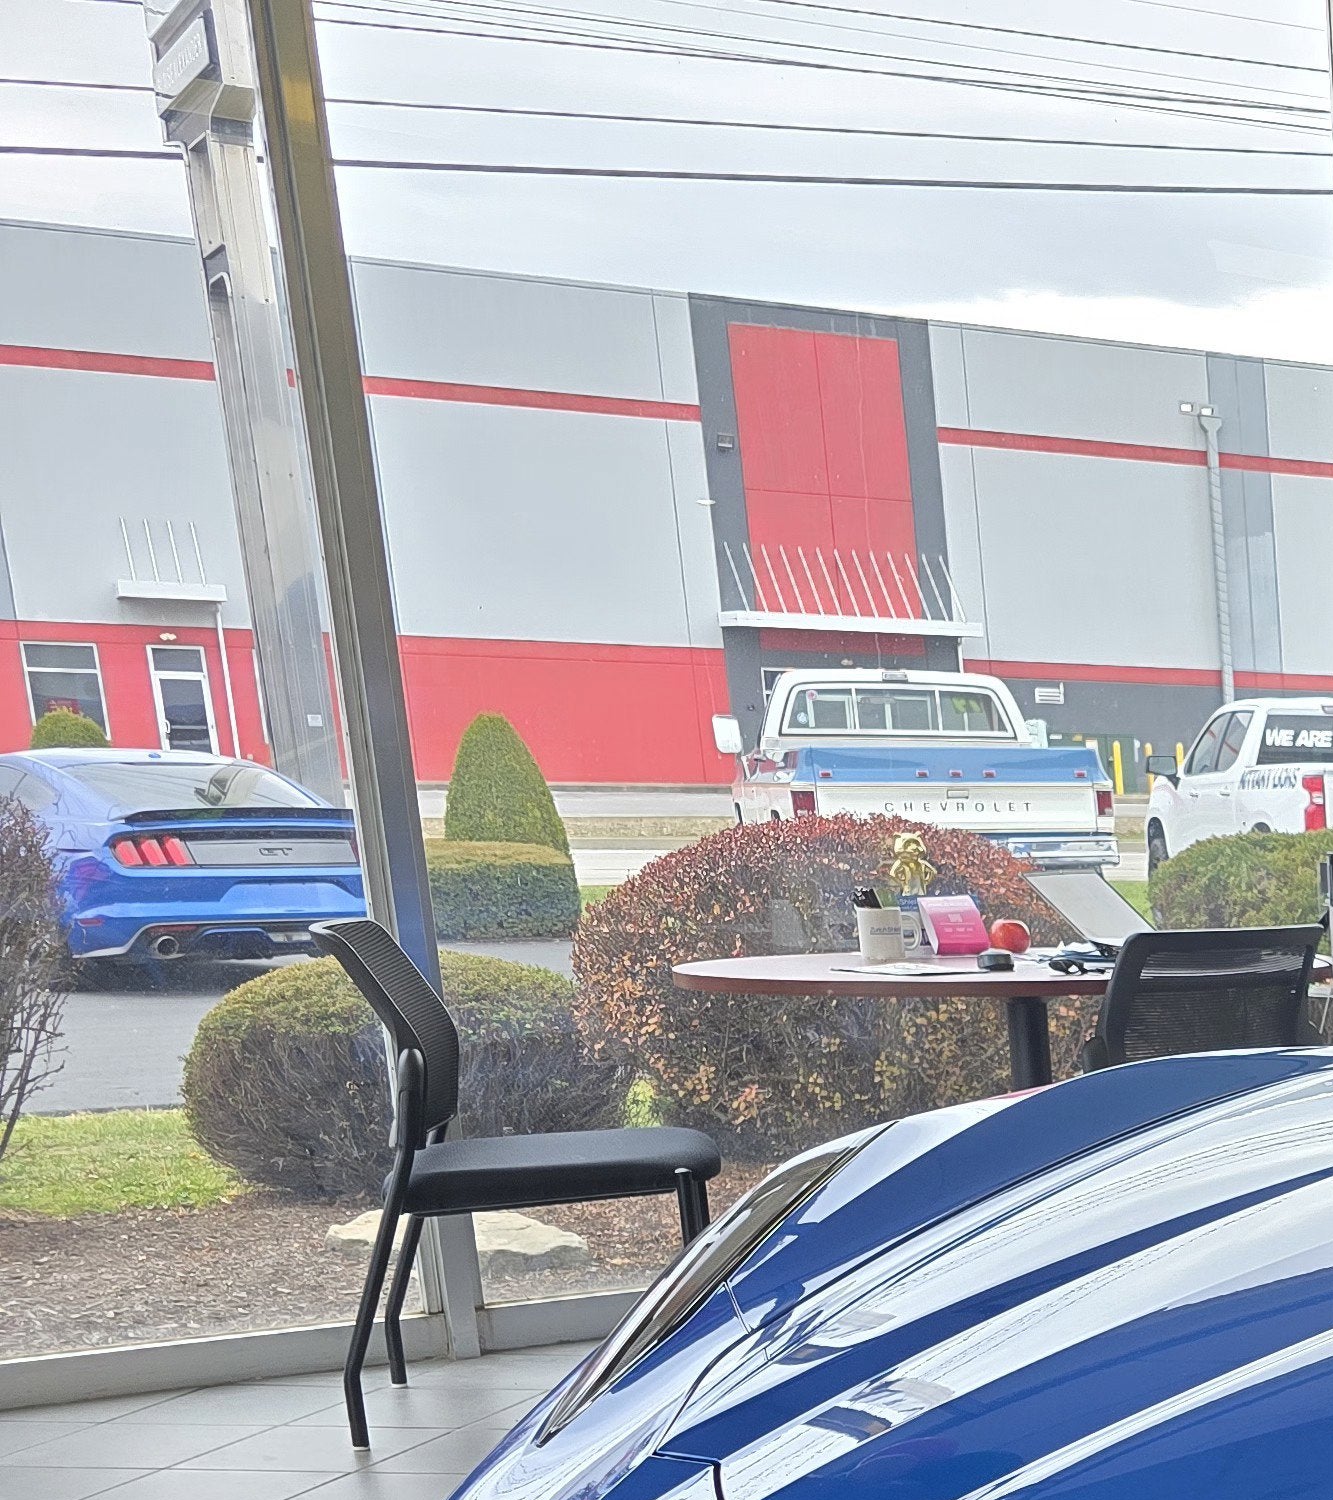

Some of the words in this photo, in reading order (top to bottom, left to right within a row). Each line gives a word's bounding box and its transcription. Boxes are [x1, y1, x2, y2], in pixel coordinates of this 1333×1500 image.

[1265, 728, 1294, 747] WE
[1296, 730, 1333, 748] ARE
[884, 802, 1032, 813] CHEVROLET
[259, 847, 292, 856] GT
